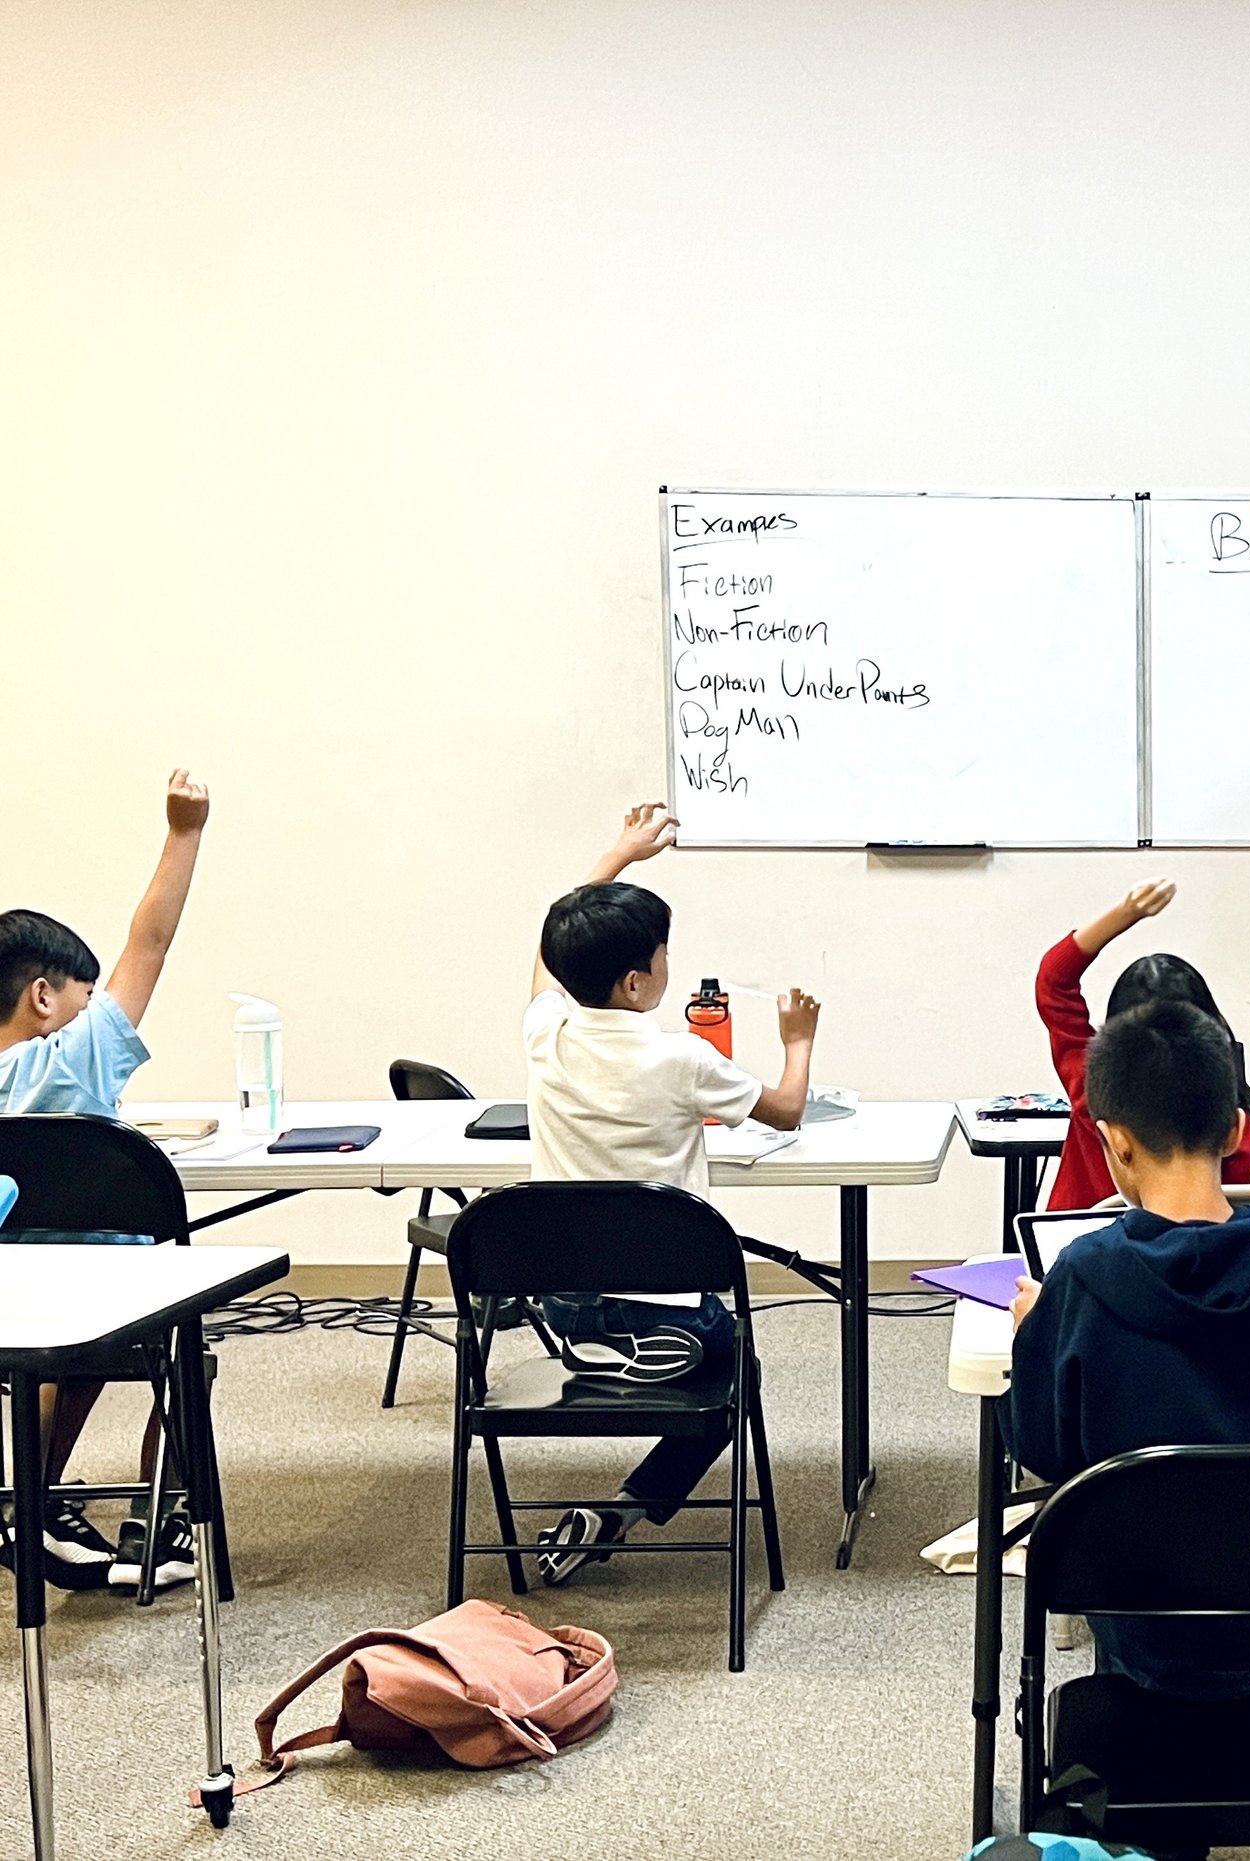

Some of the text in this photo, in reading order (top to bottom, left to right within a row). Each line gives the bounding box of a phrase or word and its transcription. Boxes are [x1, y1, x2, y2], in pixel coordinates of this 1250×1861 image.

[678, 563, 773, 600] Fiction
[674, 605, 828, 646] Non-Fiction
[674, 650, 766, 710] Captain
[679, 701, 800, 767] Dog Man
[680, 754, 748, 798] Wish
